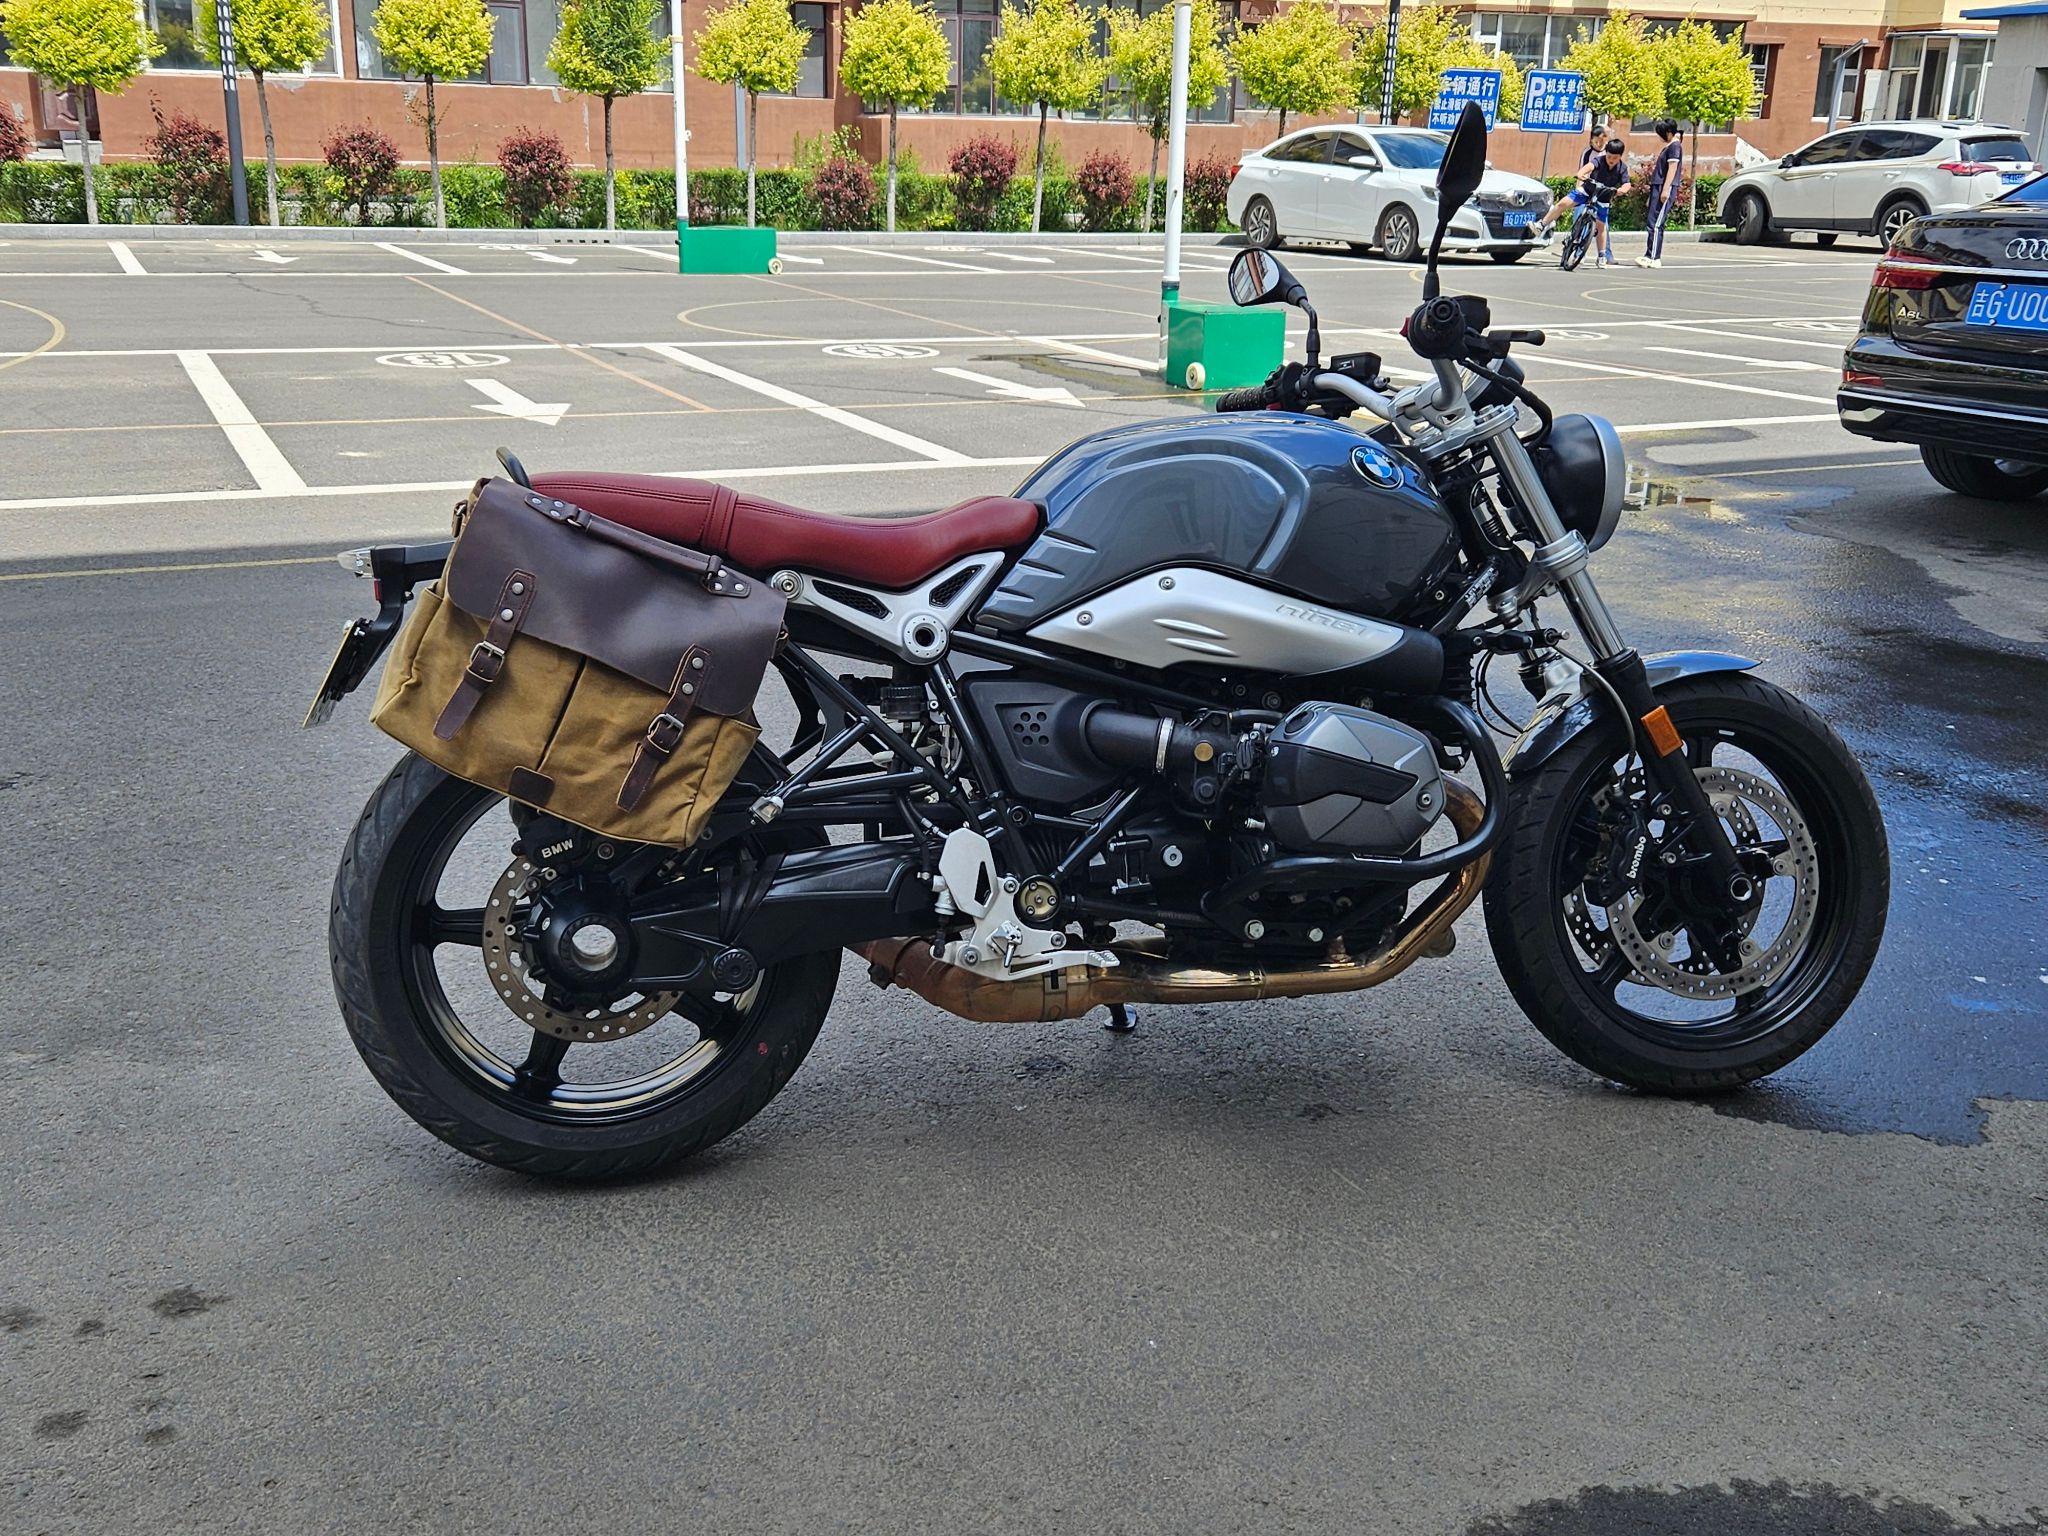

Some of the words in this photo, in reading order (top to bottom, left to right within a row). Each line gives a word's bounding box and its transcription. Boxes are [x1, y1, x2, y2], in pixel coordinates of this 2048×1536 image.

[1440, 75, 1496, 97] 车辆通行
[1547, 78, 1585, 95] 机关单位
[1897, 306, 1922, 320] A6L
[541, 838, 574, 859] BMW
